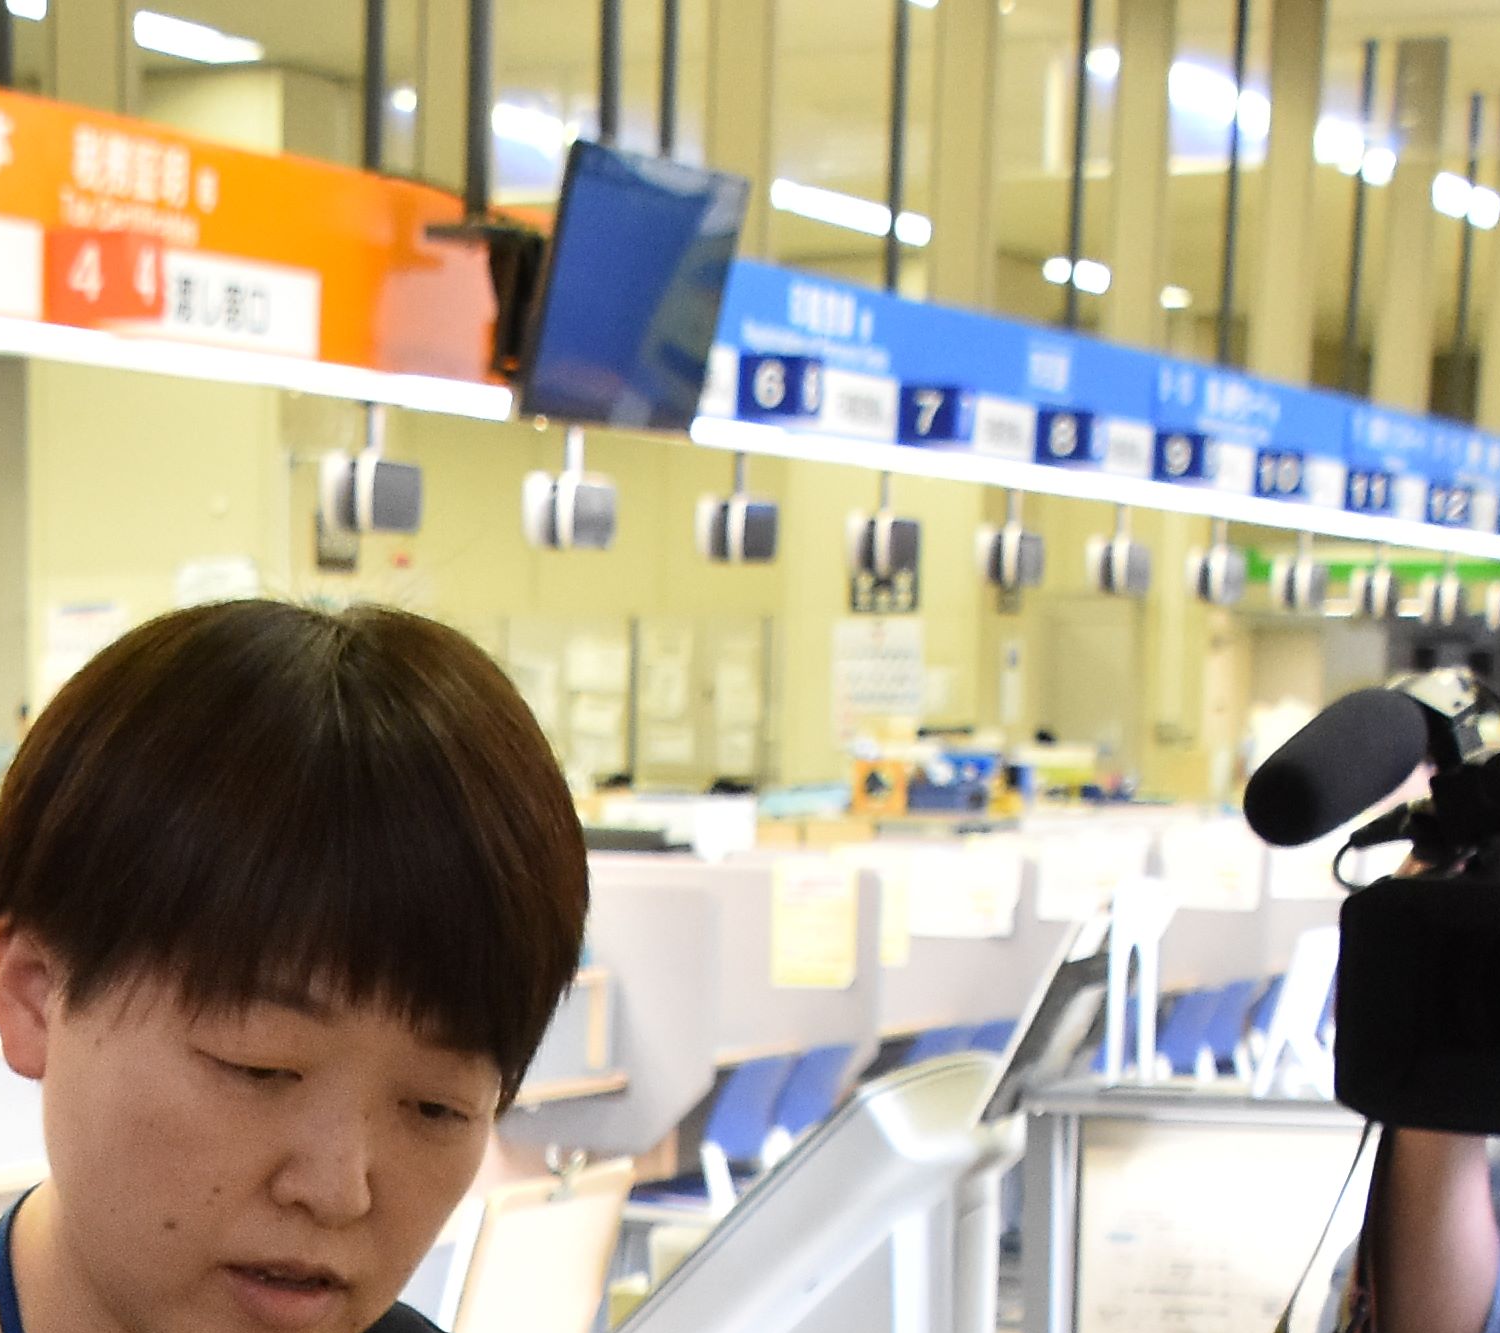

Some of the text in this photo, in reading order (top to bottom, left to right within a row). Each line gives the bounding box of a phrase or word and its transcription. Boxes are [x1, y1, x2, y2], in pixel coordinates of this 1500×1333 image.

[67, 242, 106, 303] 4
[134, 245, 157, 307] 4
[752, 357, 787, 411] 6
[915, 389, 945, 437] 7
[1048, 411, 1079, 459] 8
[1162, 435, 1194, 477] 9
[1259, 452, 1301, 496] 10
